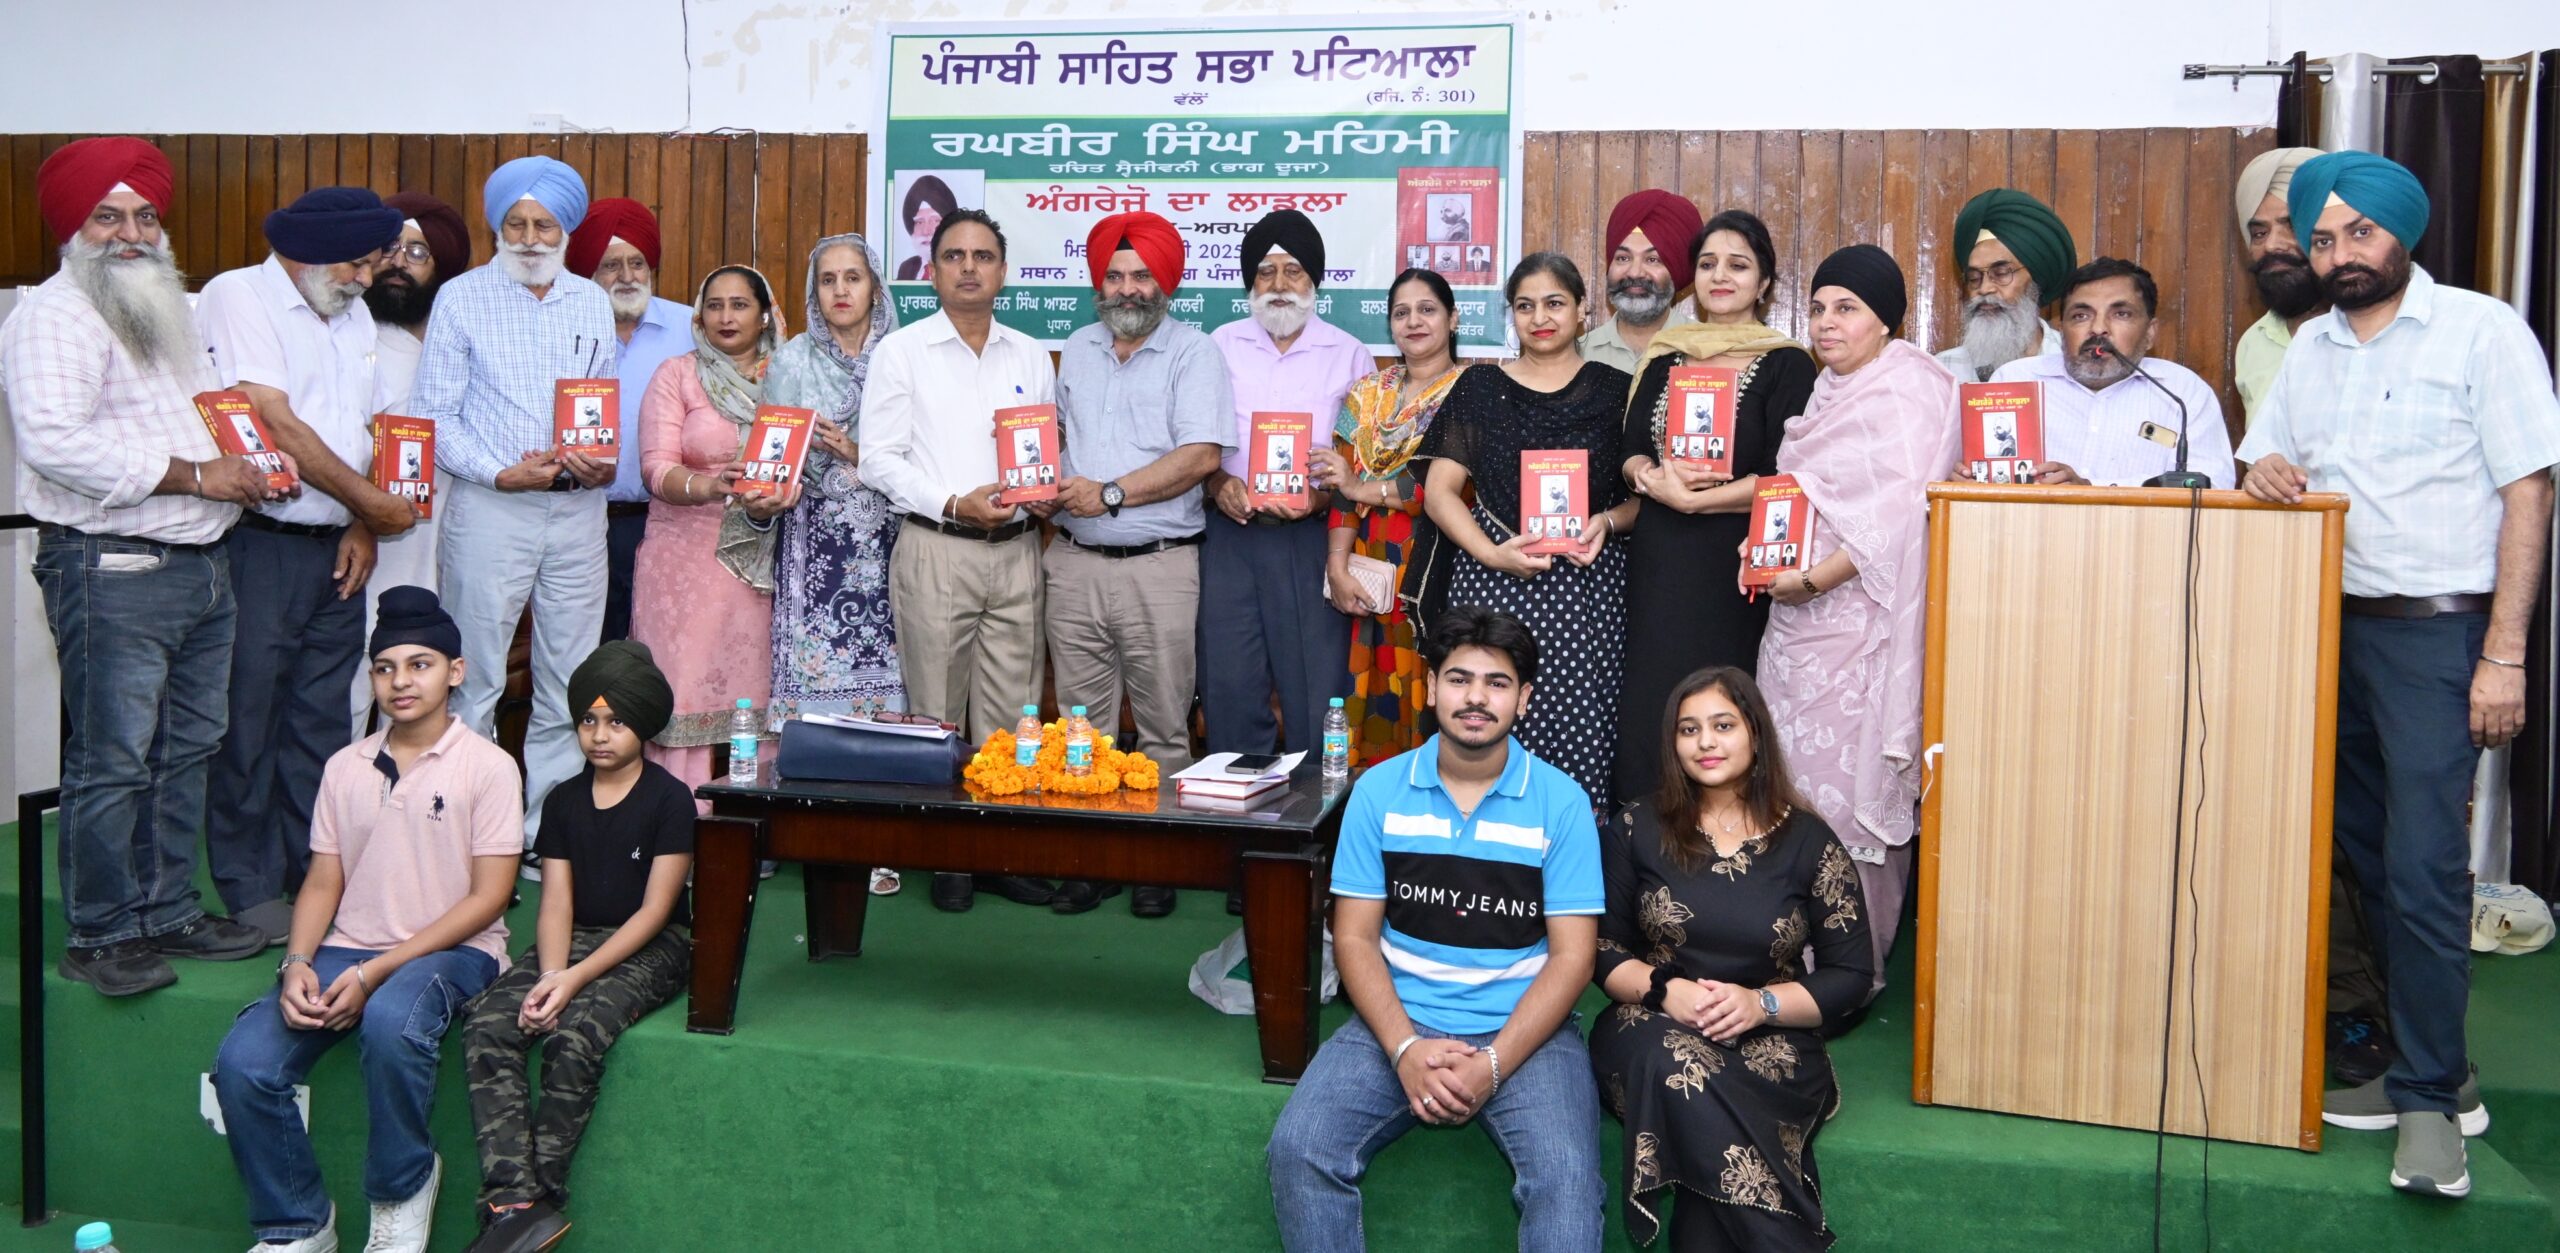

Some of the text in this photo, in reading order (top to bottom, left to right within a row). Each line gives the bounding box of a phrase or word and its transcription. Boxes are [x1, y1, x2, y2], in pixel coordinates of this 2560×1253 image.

[922, 35, 1476, 85] ਪੰਜਾਬੀ ਸਾਹਿਤ ਸਭਾ ਪਟਿਆਲਾ
[1173, 91, 1208, 106] ਵੱਲੋਂ
[1366, 86, 1475, 105] (ਰਜਿ. ਨੰ: 301)
[931, 120, 1459, 156] ਰਘਬੀਰ ਸਿੰਘ ਮਹਿਮੀ
[1049, 160, 1106, 174] ਰਚਿਤ
[1210, 161, 1265, 174] (ਭਾਗ
[1275, 161, 1330, 177] ਦੂਜਾ)
[1167, 193, 1210, 212] ਦਾ
[1227, 193, 1348, 212] ਲਾਡਲਾ
[1199, 243, 1242, 259] 2025
[1020, 267, 1067, 279] ਸਥਾਨ
[1016, 291, 1039, 311] ਸਿੰਘ
[1047, 319, 1072, 333] ਪ੍ਰਧਾਨ
[1393, 880, 1538, 917] TOMMY JEANS
